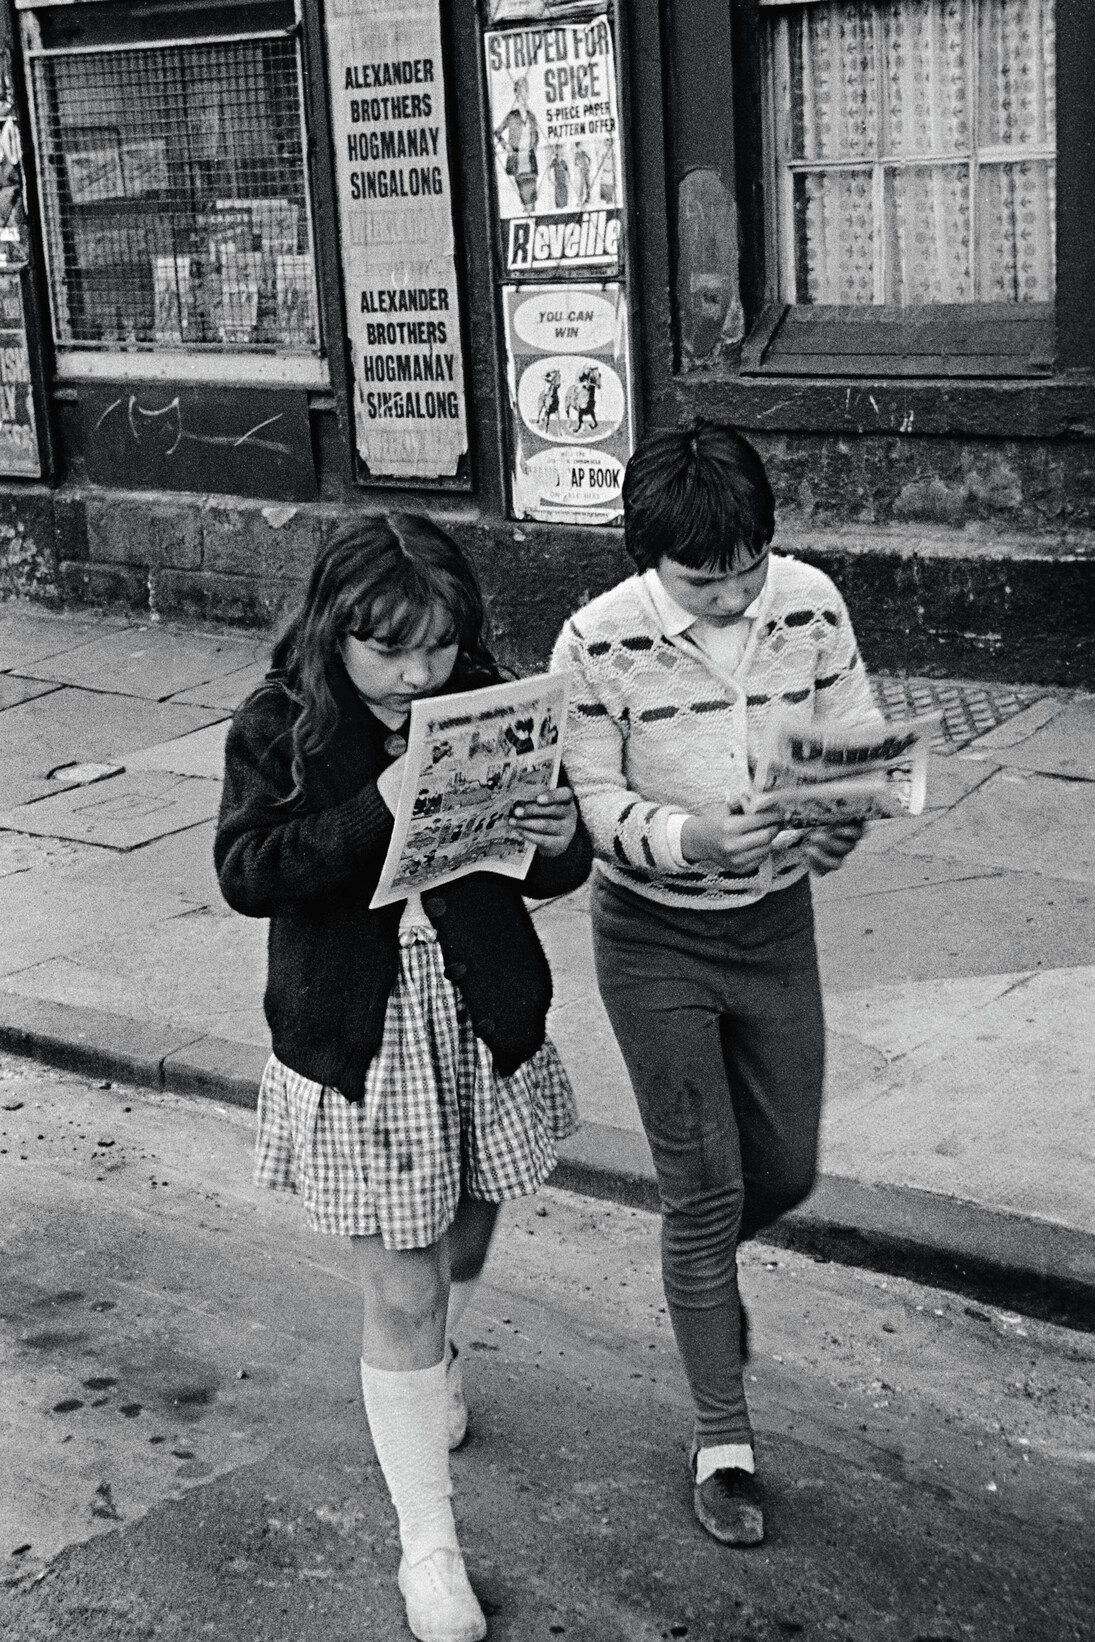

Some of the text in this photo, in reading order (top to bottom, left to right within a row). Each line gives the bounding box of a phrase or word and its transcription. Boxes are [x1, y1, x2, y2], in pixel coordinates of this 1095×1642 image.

[488, 20, 609, 71] STRIPED FOR
[345, 59, 434, 90] ALEXANDER
[544, 62, 601, 103] SPICE
[351, 94, 432, 122] BROTHERS
[546, 102, 611, 122] 5-PIECE PAPER
[547, 117, 616, 138] PATTERN OFFER
[347, 127, 439, 161] HOGMANAY
[350, 167, 443, 200] SINGALONG
[507, 211, 621, 270] Reveille
[361, 288, 449, 313] ALEXANDER
[539, 311, 594, 323] YOU CAN
[367, 321, 447, 345] BROTHERS
[555, 327, 579, 338] WIN
[364, 354, 454, 382] HOGMANAY
[367, 392, 459, 419] SINGALONG
[589, 468, 620, 488] BOOK
